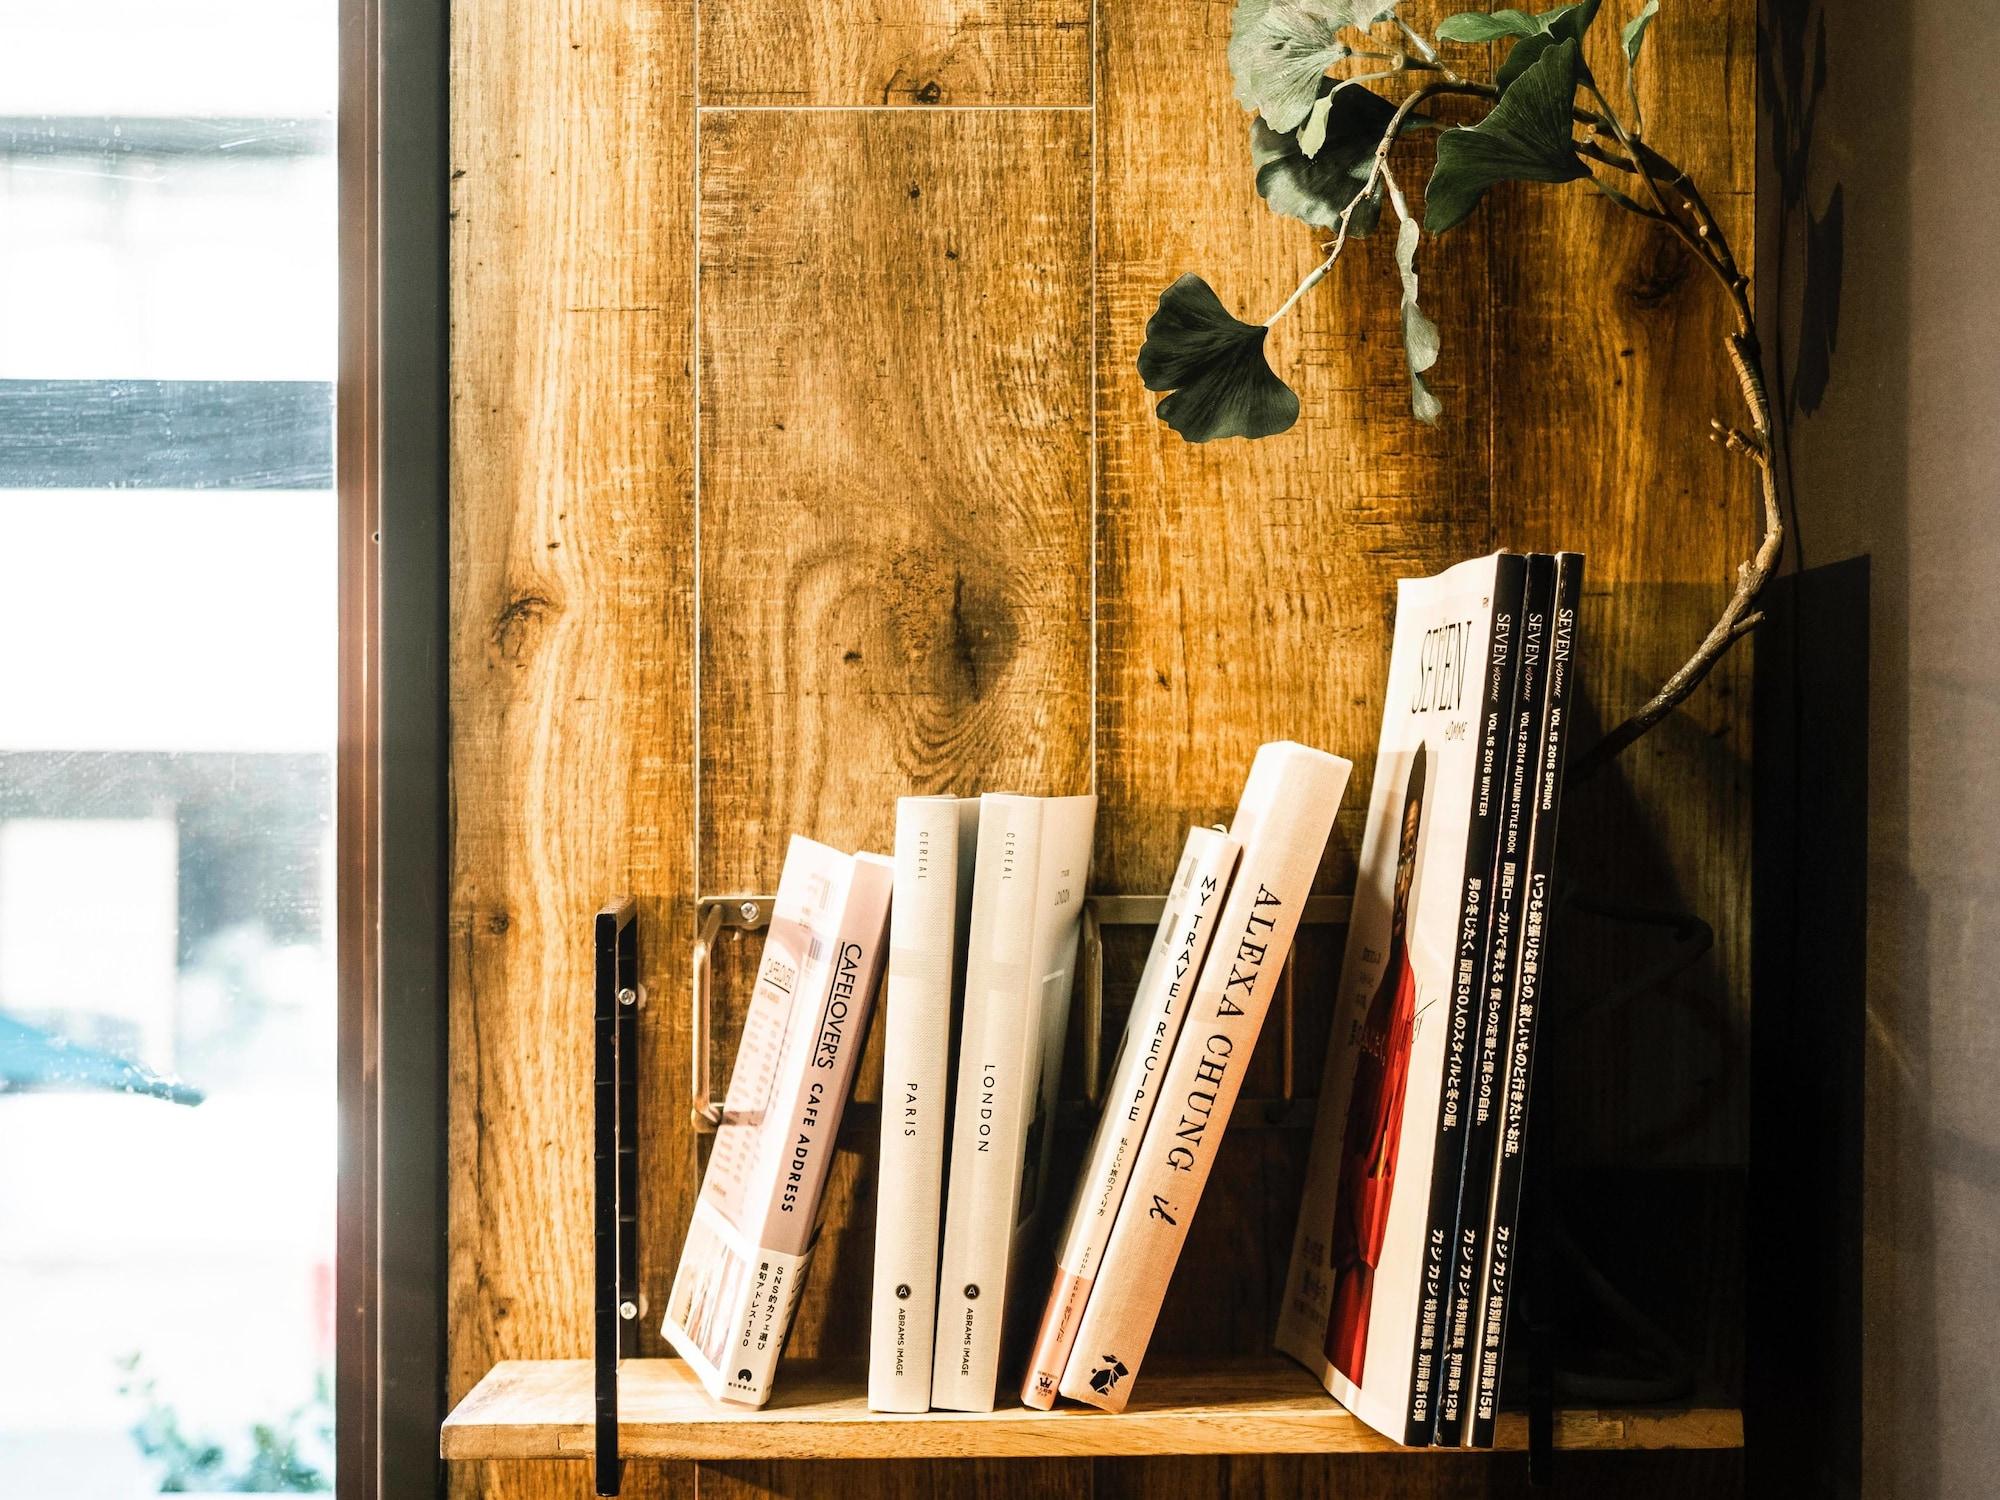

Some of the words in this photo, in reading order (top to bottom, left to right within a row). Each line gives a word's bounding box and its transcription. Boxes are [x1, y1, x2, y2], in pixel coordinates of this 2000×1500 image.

[1493, 613, 1511, 666] SEVEN
[1525, 613, 1543, 666] SEVEN
[1556, 608, 1574, 661] SEVEN
[1486, 713, 1498, 747] VOL.16
[1518, 711, 1530, 743] VOL.12
[1549, 708, 1561, 742] VOL.15
[1483, 749, 1494, 775] 2016
[1516, 743, 1527, 764] 2014
[1546, 744, 1558, 770] 2016
[1478, 775, 1492, 817] WINTER
[1511, 765, 1524, 801] AUTUMN
[1542, 771, 1555, 811] SPRING
[1508, 801, 1520, 829] STYLE
[917, 831, 929, 880] CEREAL
[1002, 832, 1016, 881] CEREAL
[1507, 830, 1517, 854] BOOK
[1200, 875, 1216, 907] MY
[1165, 914, 1203, 1014] TRAVEL
[1217, 883, 1282, 1018] ALEXA
[816, 943, 862, 1070] CAFELOVER'S
[1128, 1021, 1166, 1122] RECIPE
[802, 1082, 823, 1127] CAFE
[904, 1083, 918, 1137] PARIS
[978, 1064, 996, 1153] LONDON
[1166, 1034, 1233, 1172] CHUNG
[781, 1134, 810, 1213] ADDRESS
[742, 1262, 769, 1347] 最旬アドレス150
[757, 1265, 784, 1350] SNS的カフェ選び
[897, 1307, 906, 1346] ABRAMS
[963, 1307, 974, 1346] ABRAMS
[896, 1348, 904, 1376] IMAGE
[961, 1348, 970, 1376] IMAGE
